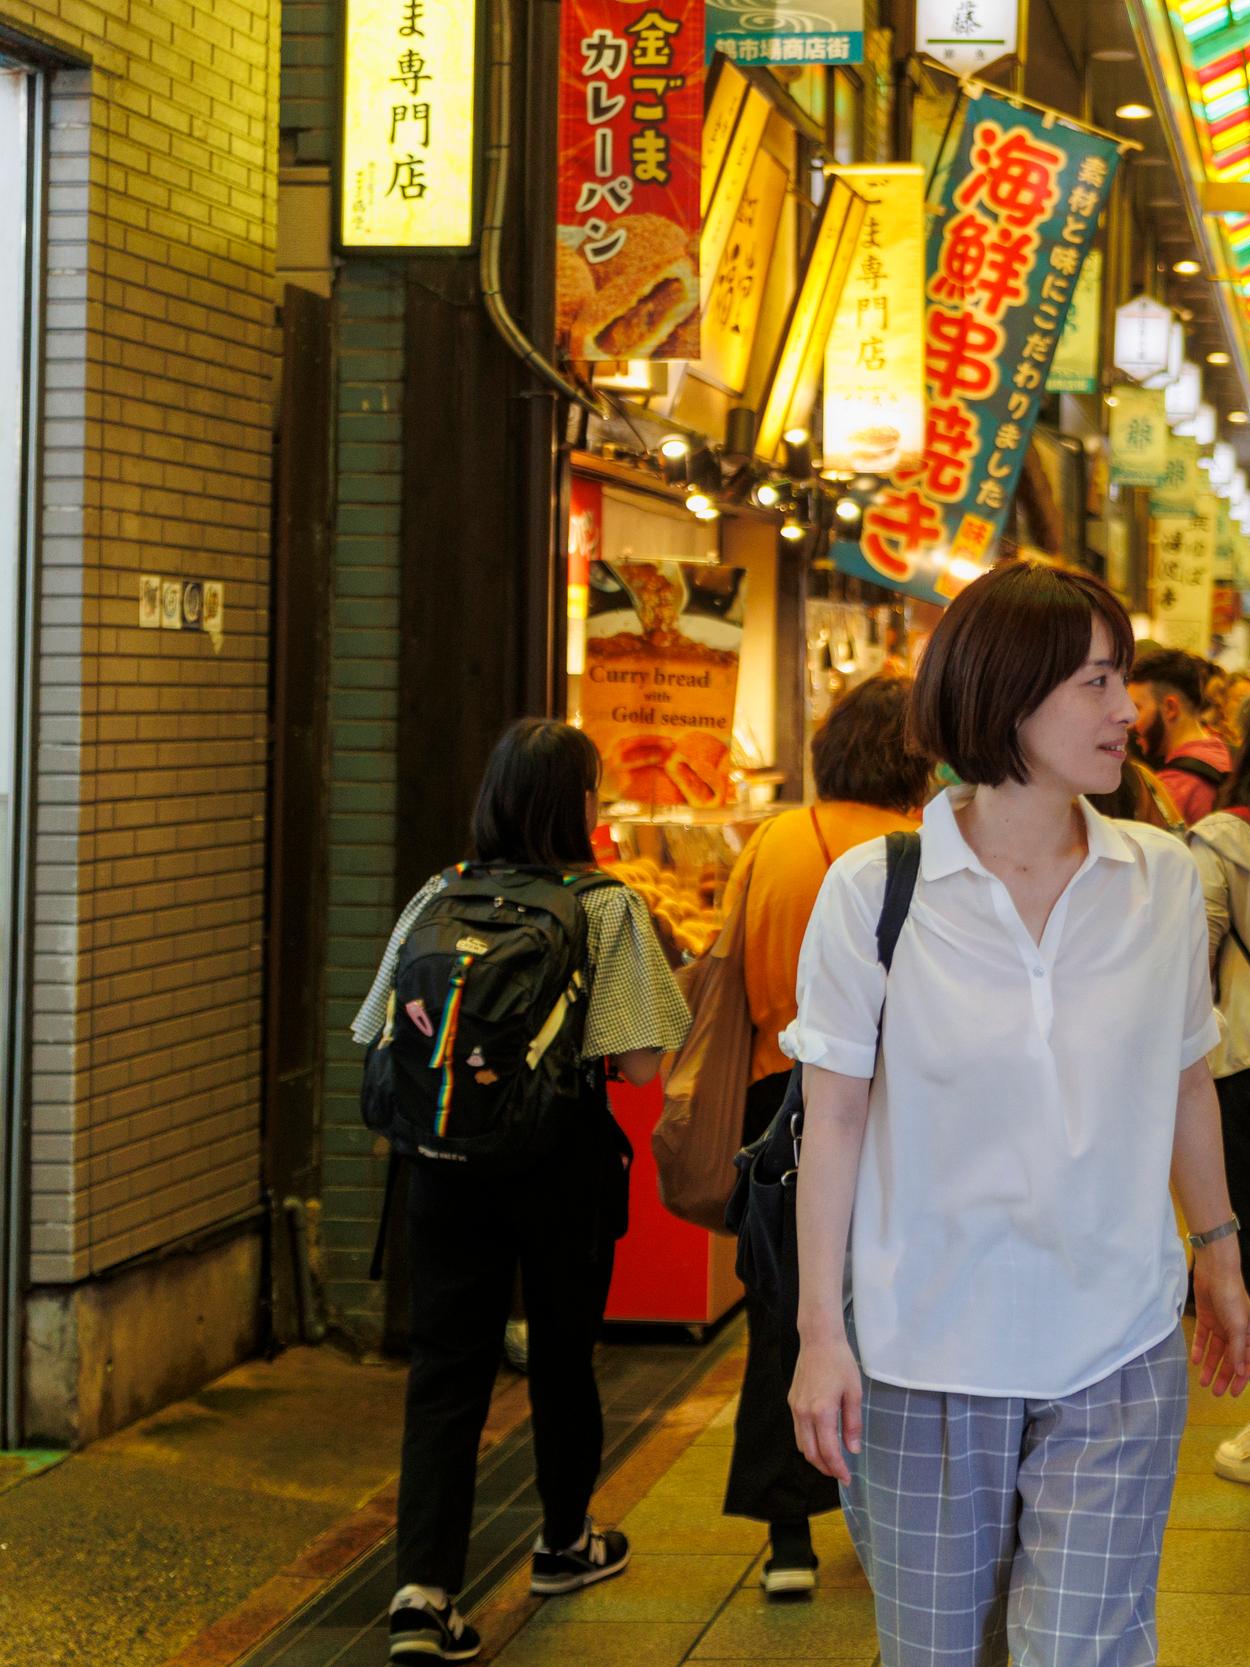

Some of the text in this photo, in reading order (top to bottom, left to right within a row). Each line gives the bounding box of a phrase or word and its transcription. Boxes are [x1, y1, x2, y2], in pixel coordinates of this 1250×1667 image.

[575, 29, 634, 265] カレーパン
[624, 8, 687, 190] 金ごま
[855, 178, 891, 372] ごま専門店
[863, 122, 1066, 582] 海鮮串焼き
[976, 155, 1109, 509] 素材と味にこだわりました
[588, 664, 711, 688] Curry bread
[611, 705, 727, 729] Gold sesame
[643, 691, 671, 703] with
